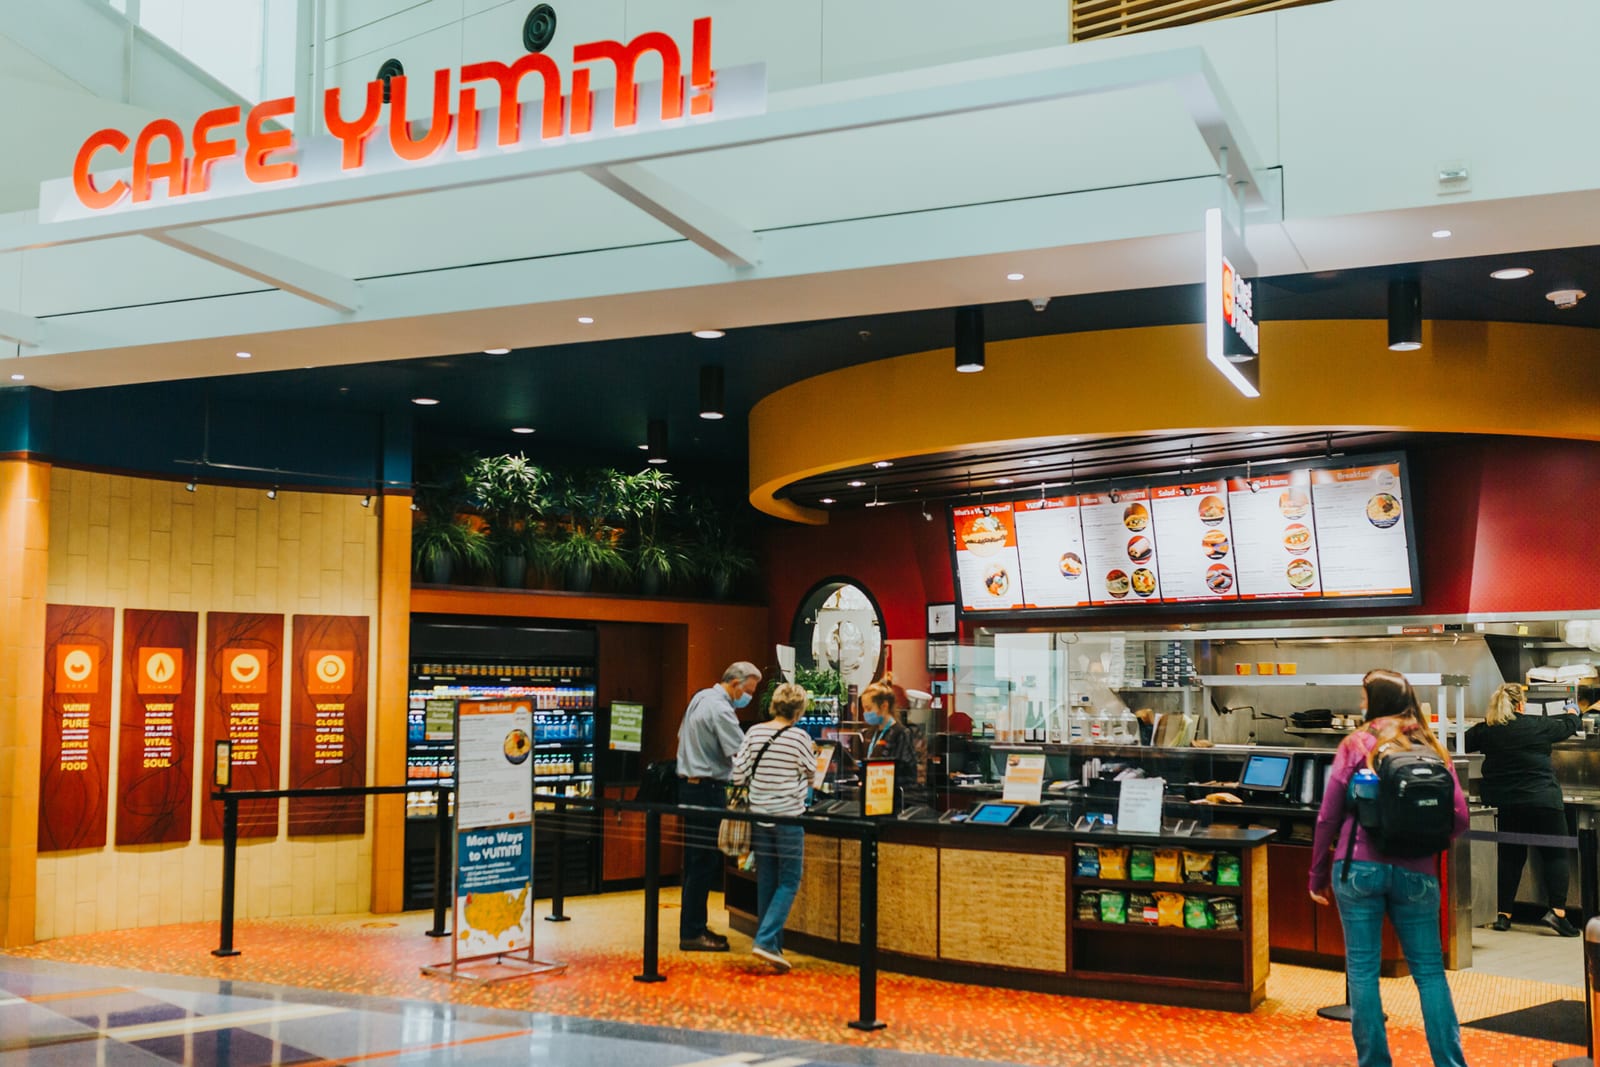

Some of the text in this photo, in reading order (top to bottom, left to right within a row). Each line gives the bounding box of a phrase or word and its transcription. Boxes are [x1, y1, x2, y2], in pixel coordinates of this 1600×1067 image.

[73, 96, 298, 210] CAFE
[479, 703, 512, 713] Breakfast
[62, 718, 89, 728] PURE
[315, 734, 343, 742] OPEN
[60, 761, 88, 771] FOOD
[143, 758, 171, 767] SOUL
[466, 832, 523, 847] More Ways
[468, 851, 481, 862] to
